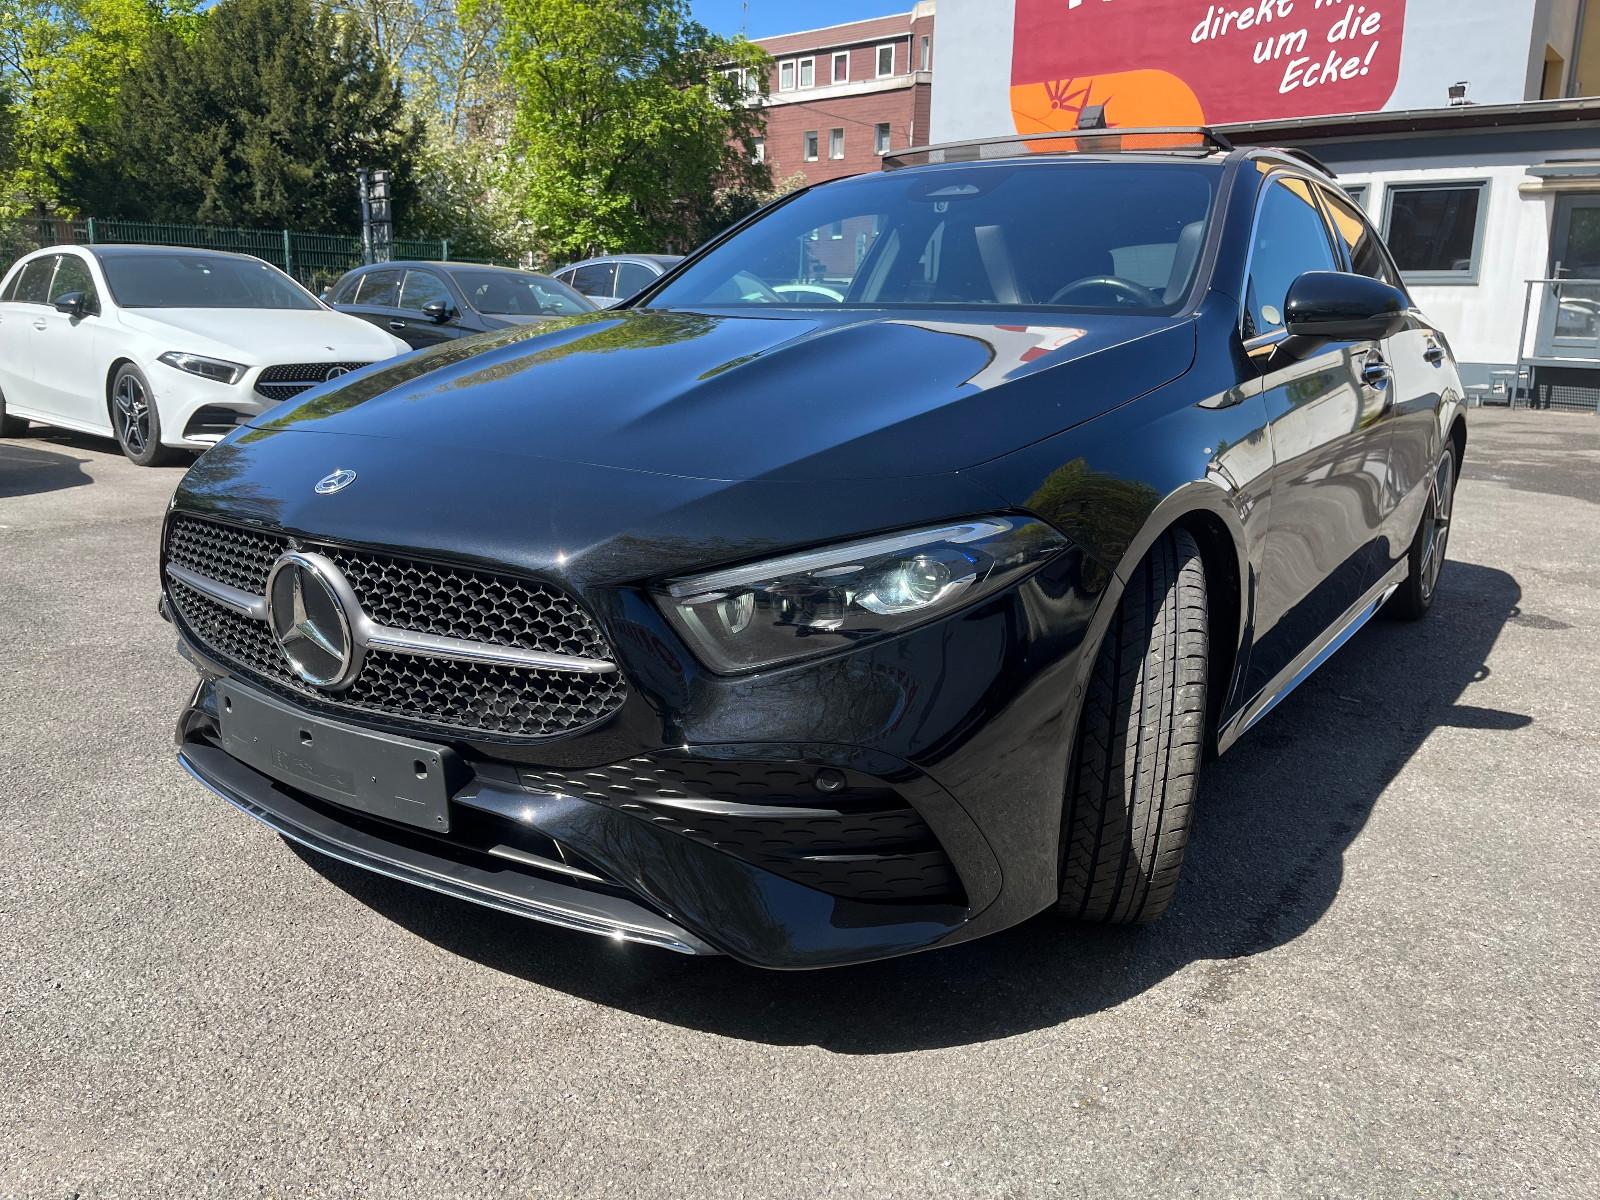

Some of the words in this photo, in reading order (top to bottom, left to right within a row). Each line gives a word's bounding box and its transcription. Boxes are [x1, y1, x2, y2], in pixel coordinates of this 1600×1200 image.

[1191, 0, 1294, 44] direkt
[1253, 28, 1308, 64] um
[1326, 3, 1381, 43] die
[1278, 40, 1379, 94] Ecke!
